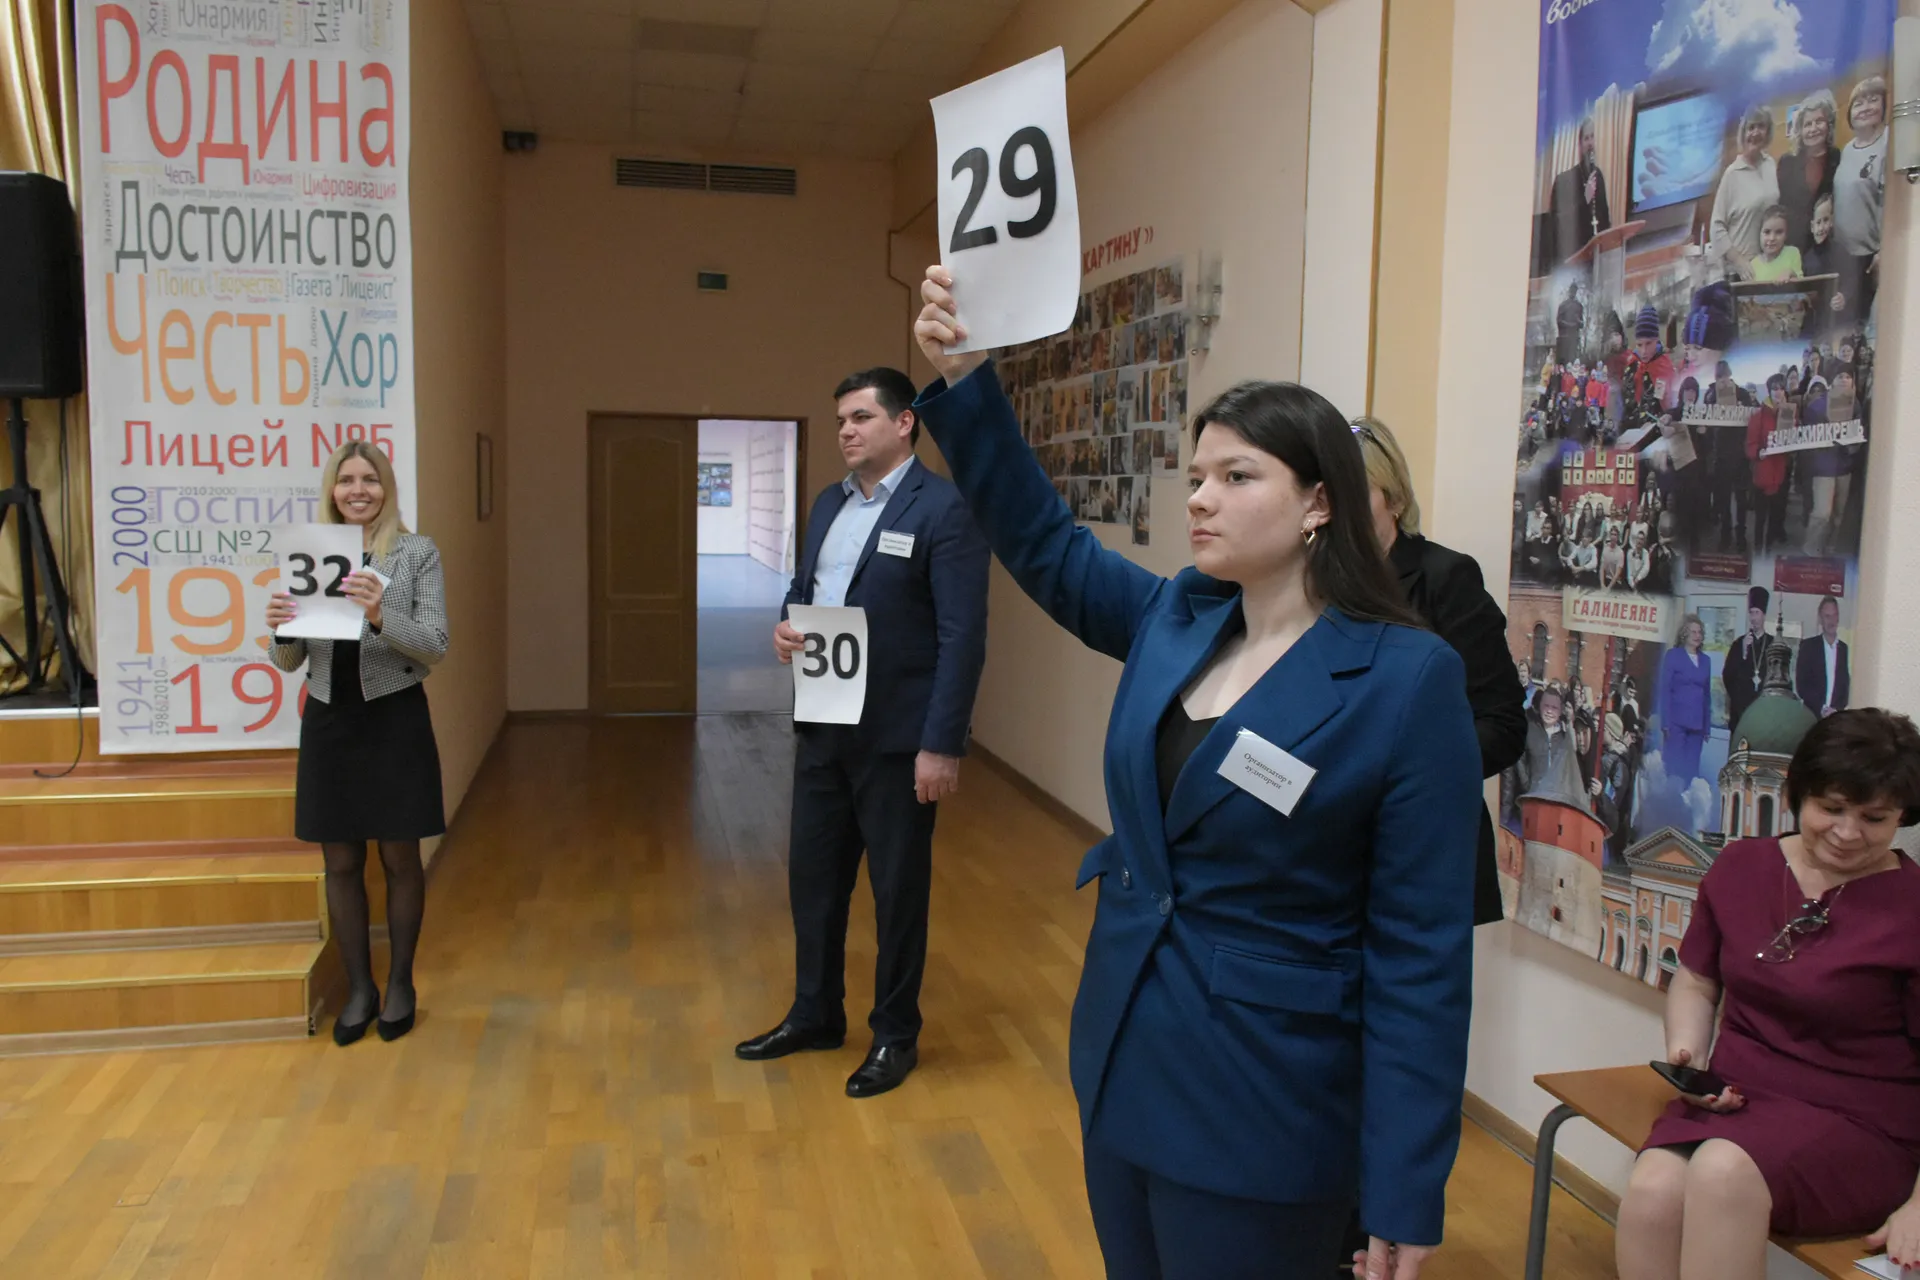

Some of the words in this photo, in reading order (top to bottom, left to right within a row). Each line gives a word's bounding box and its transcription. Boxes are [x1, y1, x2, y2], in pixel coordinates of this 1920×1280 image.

[178, 0, 268, 38] Юнармия
[96, 4, 395, 185] Родина
[302, 173, 397, 201] Цифровизация
[950, 126, 1057, 253] 29
[116, 180, 396, 274] Достоинство
[156, 269, 207, 298] Поиск
[105, 272, 310, 406] Честь
[320, 309, 398, 408] Хор
[121, 419, 288, 475] Лицей
[111, 486, 148, 567] 2000
[155, 486, 320, 524] Госпит
[153, 529, 203, 553] СШ
[202, 555, 234, 566] 1941
[288, 553, 351, 597] 32
[1573, 598, 1657, 624] ГАЛИЛЕЯНЕ
[803, 633, 860, 679] 30
[116, 656, 154, 737] 1941
[1243, 752, 1287, 783] Организатор
[1244, 764, 1283, 790] аудитории
